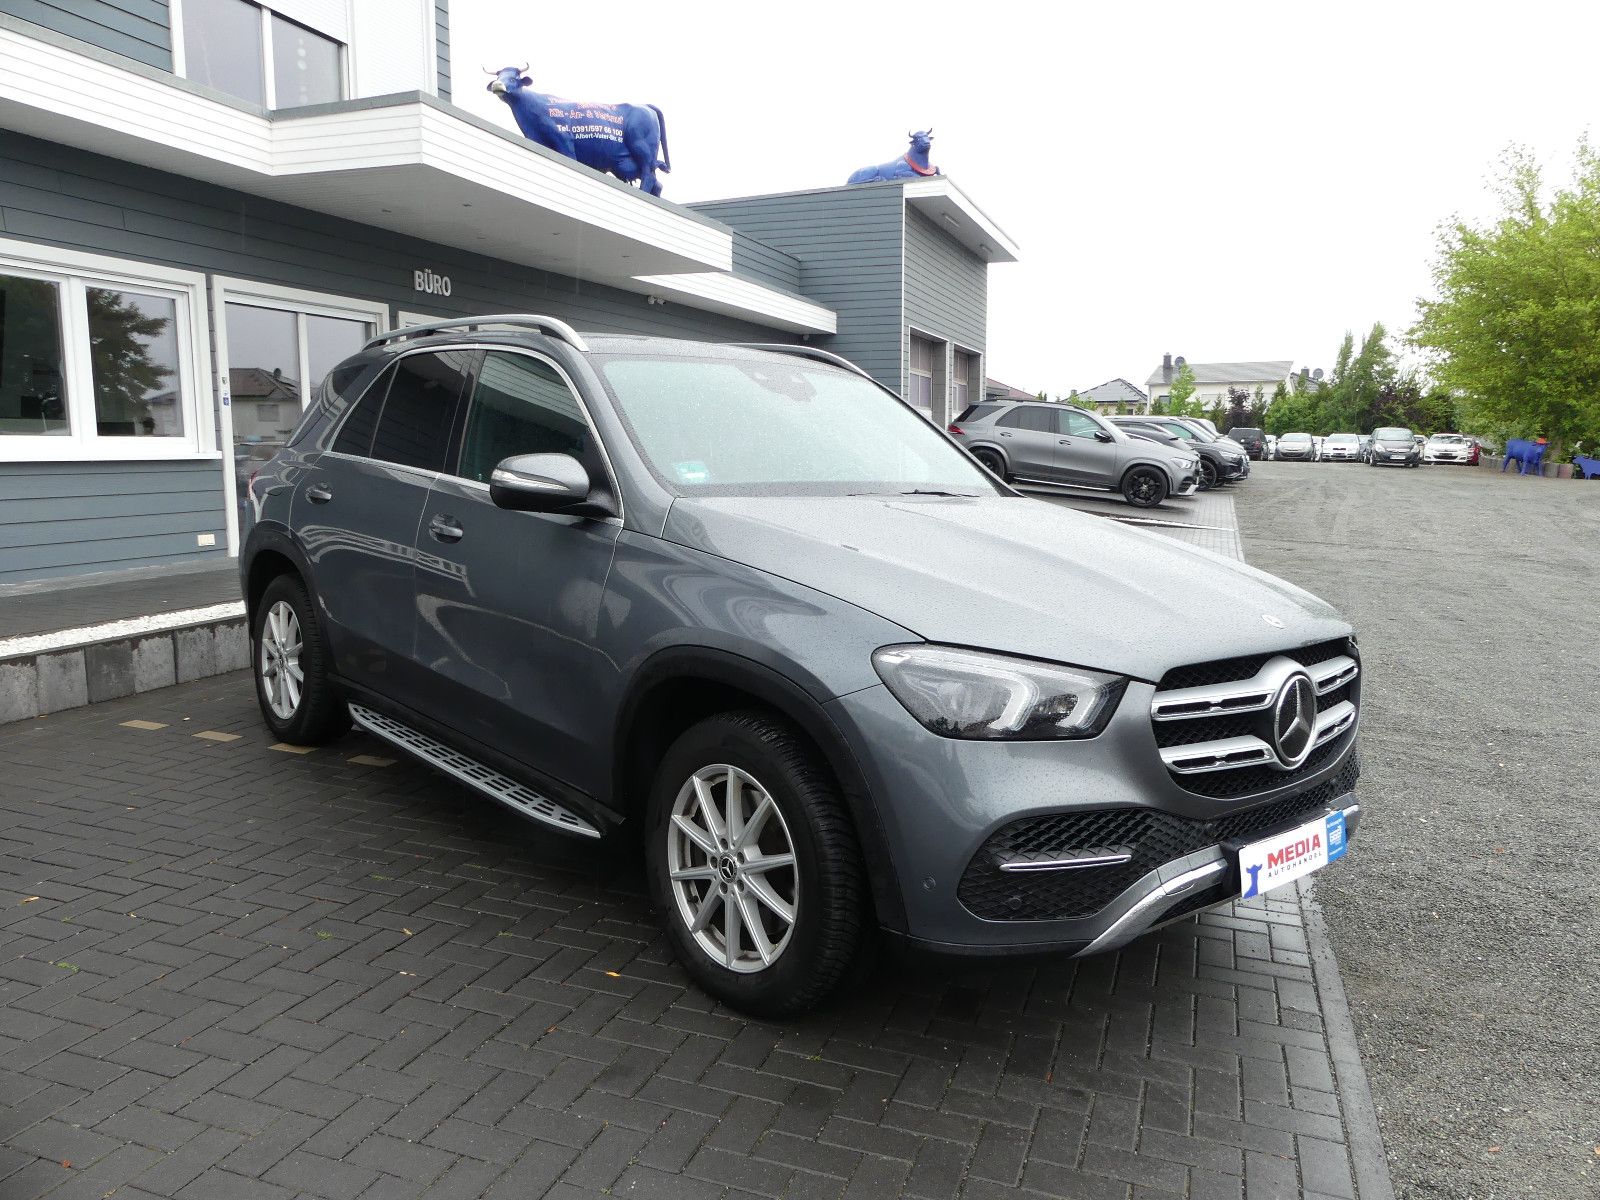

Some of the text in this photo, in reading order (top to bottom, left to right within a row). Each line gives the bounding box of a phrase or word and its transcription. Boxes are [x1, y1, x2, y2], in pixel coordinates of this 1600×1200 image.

[556, 124, 570, 132] Tel.
[414, 268, 451, 297] BÜRO
[1267, 833, 1321, 869] MEDIA
[1268, 851, 1323, 878] AUTOHANDEL
